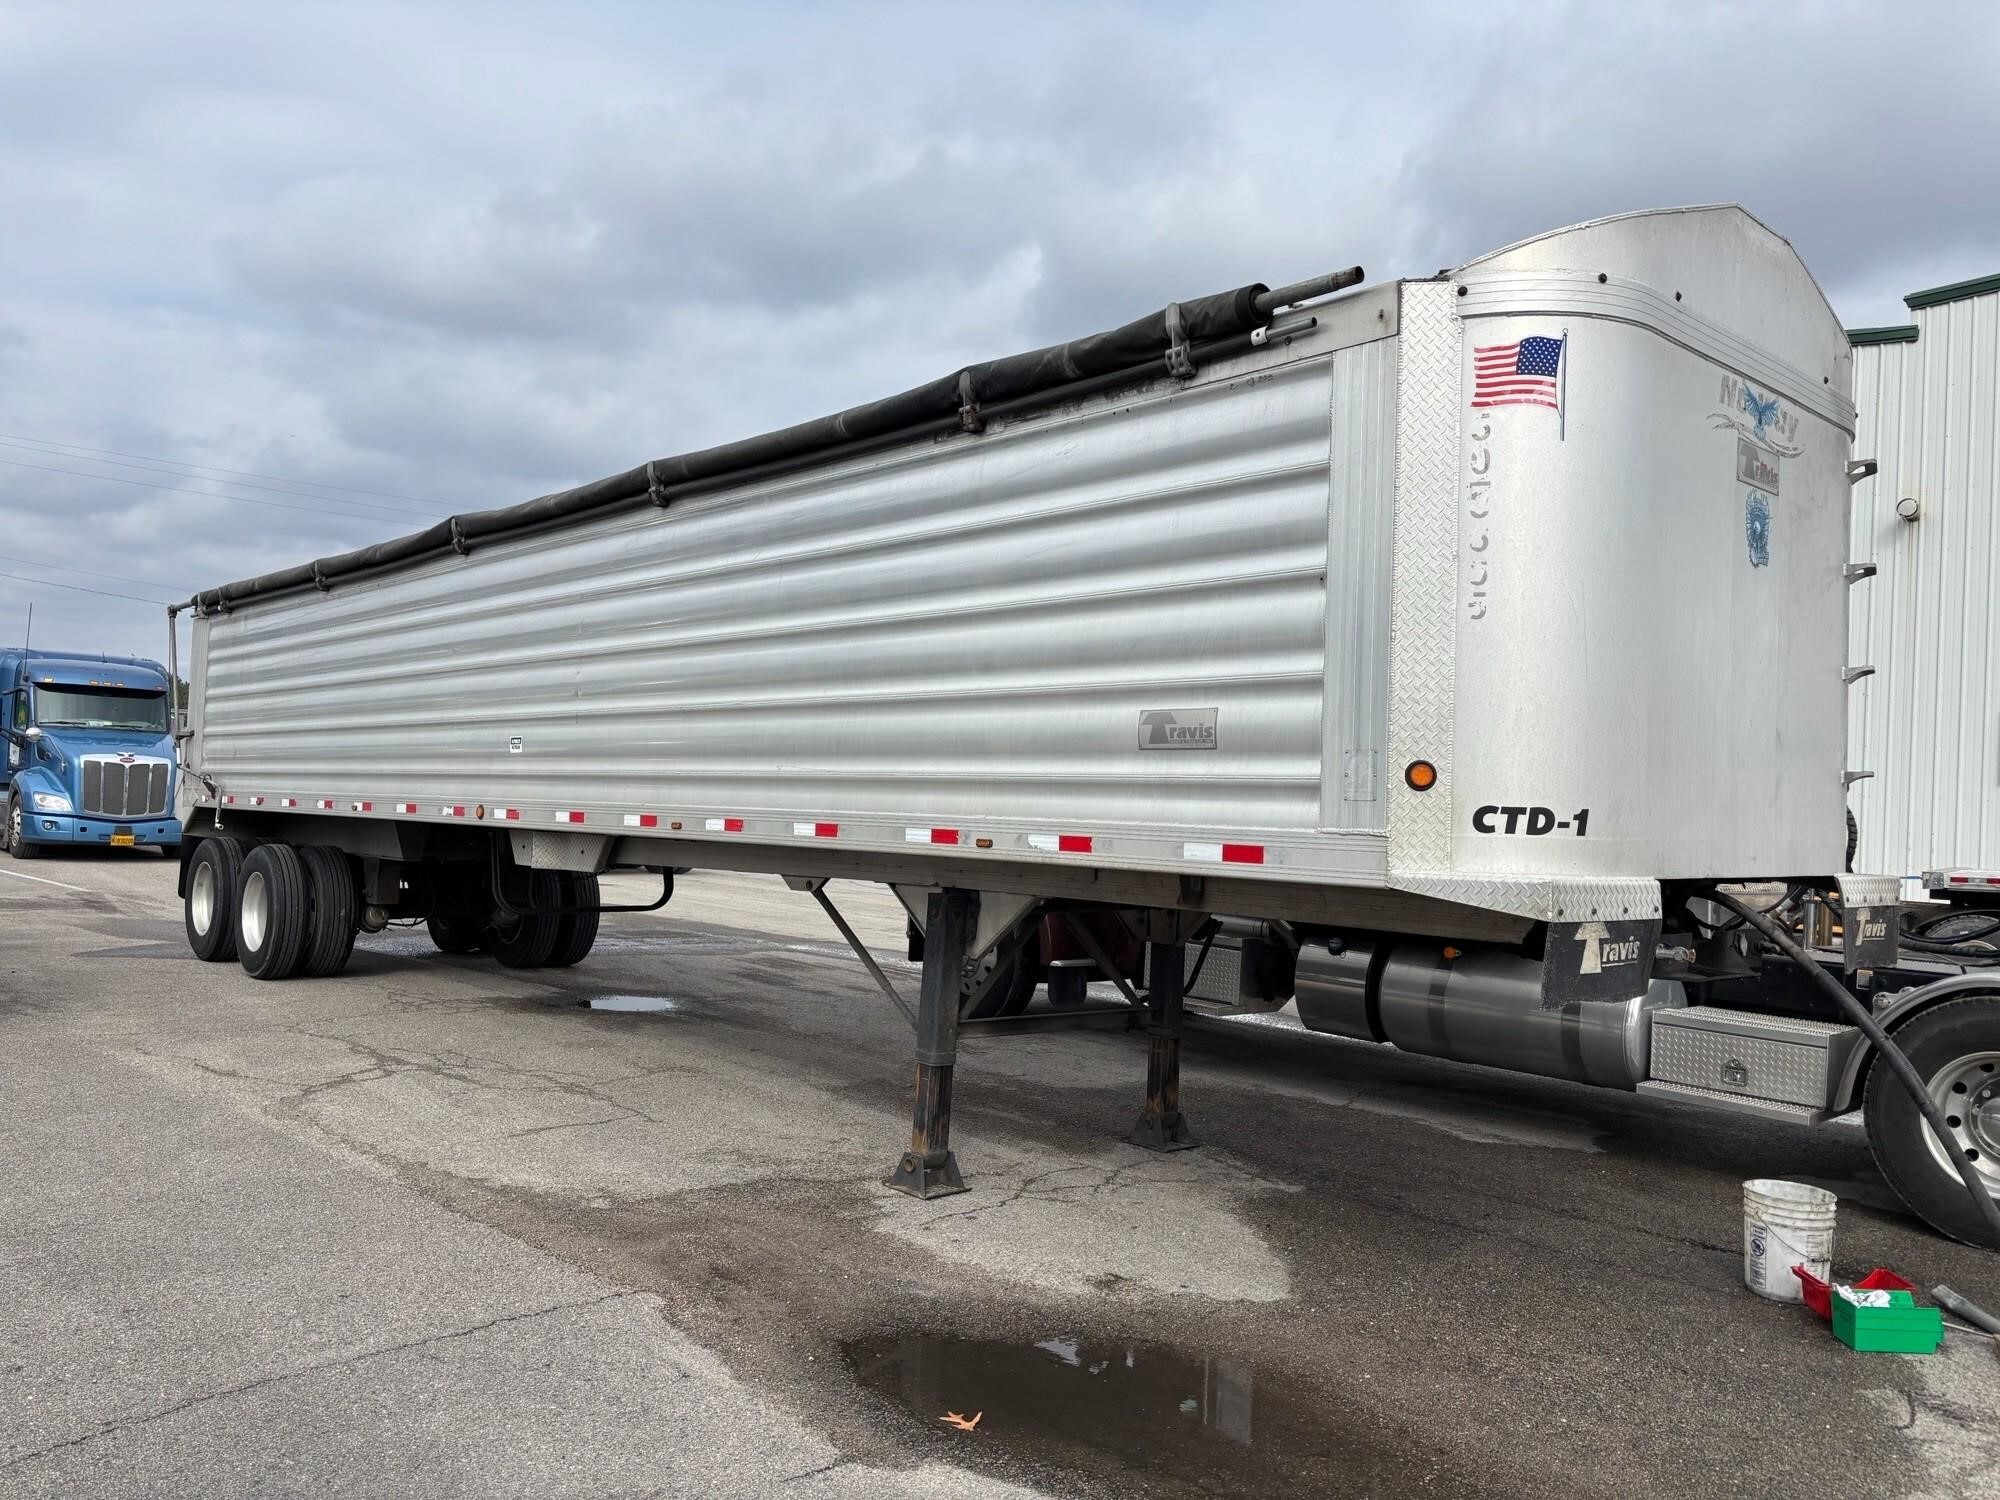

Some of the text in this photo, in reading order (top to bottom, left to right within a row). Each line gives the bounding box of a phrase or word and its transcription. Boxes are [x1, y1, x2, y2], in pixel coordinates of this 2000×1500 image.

[1141, 711, 1213, 745] Travis
[1472, 805, 1590, 837] CTD-1
[1855, 907, 1887, 946] Travis
[1573, 921, 1640, 975] Travis
